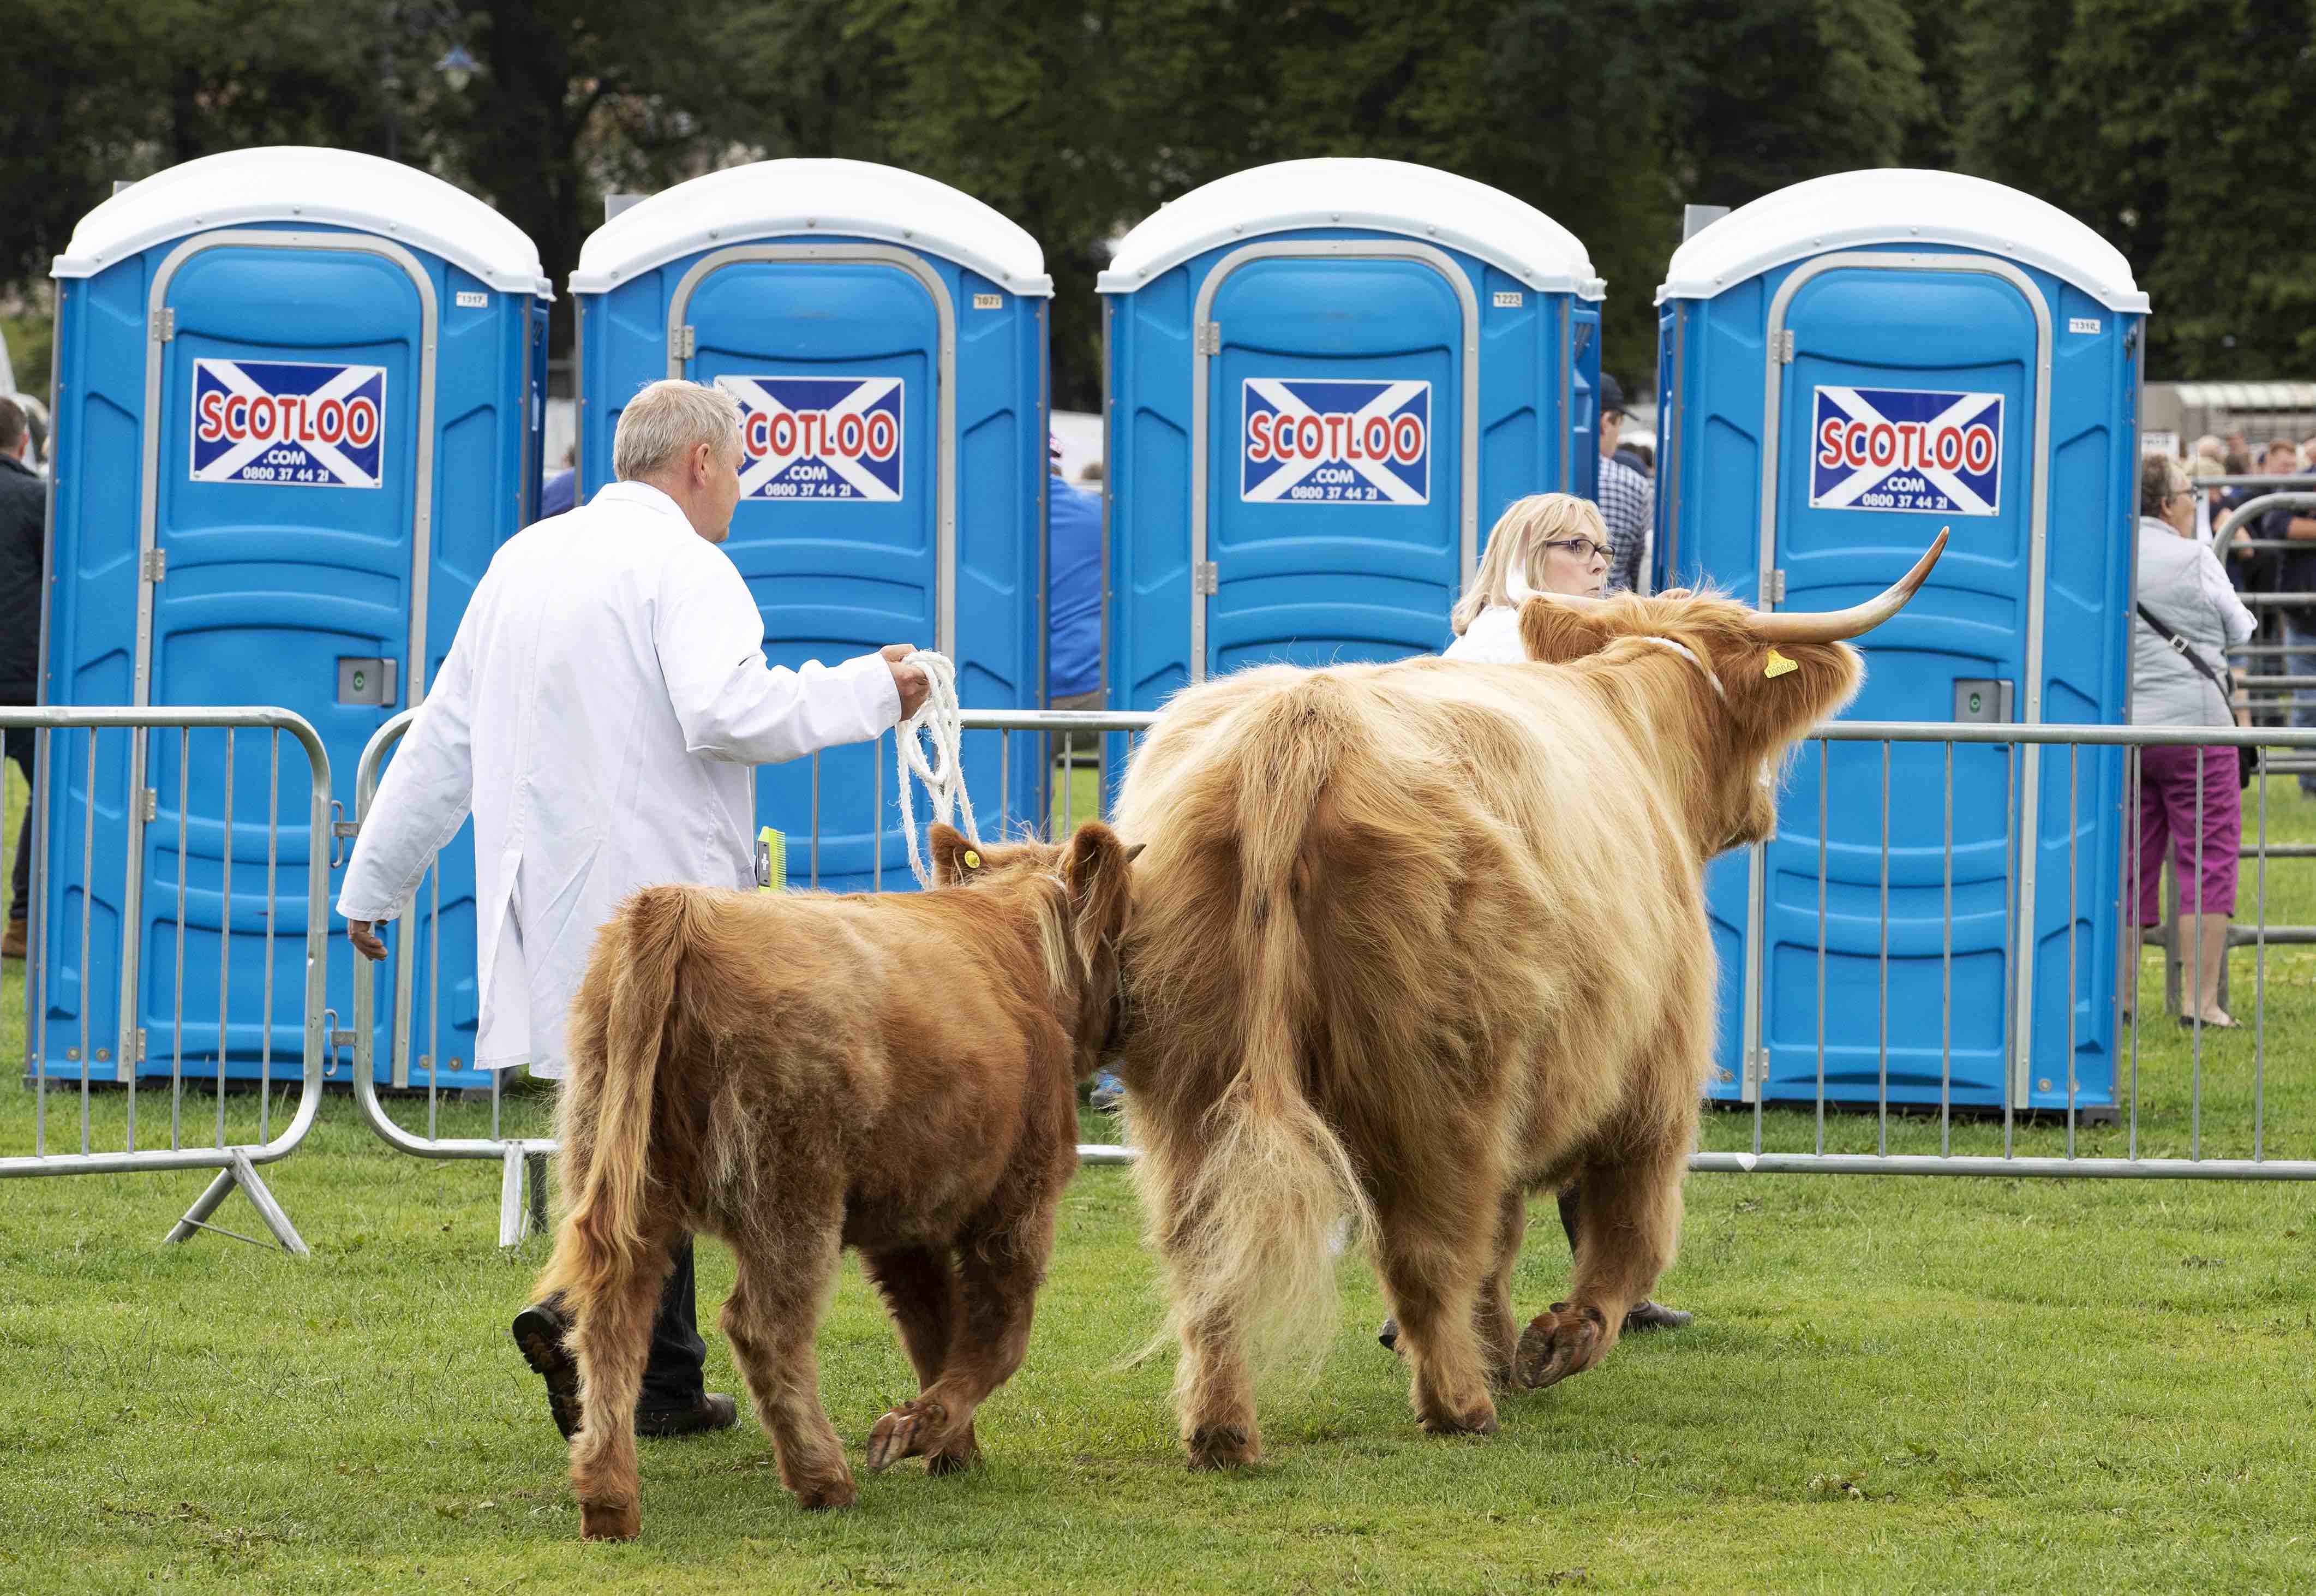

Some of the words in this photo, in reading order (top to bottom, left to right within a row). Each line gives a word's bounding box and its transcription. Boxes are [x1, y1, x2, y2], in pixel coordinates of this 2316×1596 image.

[202, 394, 375, 445] SCOTLOO
[745, 412, 894, 458] COTLOO
[1252, 414, 1421, 461] SCOTLOO
[1822, 420, 1992, 472] SCOTLOO
[263, 450, 306, 465] .COM
[242, 467, 274, 480] 0800
[278, 468, 294, 481] 37
[296, 469, 313, 482] 44
[317, 470, 329, 482] 21
[785, 466, 828, 481] .COM
[1310, 469, 1355, 483] .COM
[765, 483, 797, 497] 0800
[800, 483, 816, 497] 37
[818, 484, 836, 497] 44
[839, 485, 851, 497] 21
[1882, 477, 1925, 492] .COM
[1291, 486, 1324, 499] 0800
[1326, 487, 1342, 499] 37
[1345, 487, 1362, 500] 44
[1366, 488, 1377, 500] 21
[1862, 493, 1894, 507] 0800
[1897, 494, 1913, 508] 37
[1916, 495, 1933, 509] 44
[1936, 496, 1947, 509] 21
